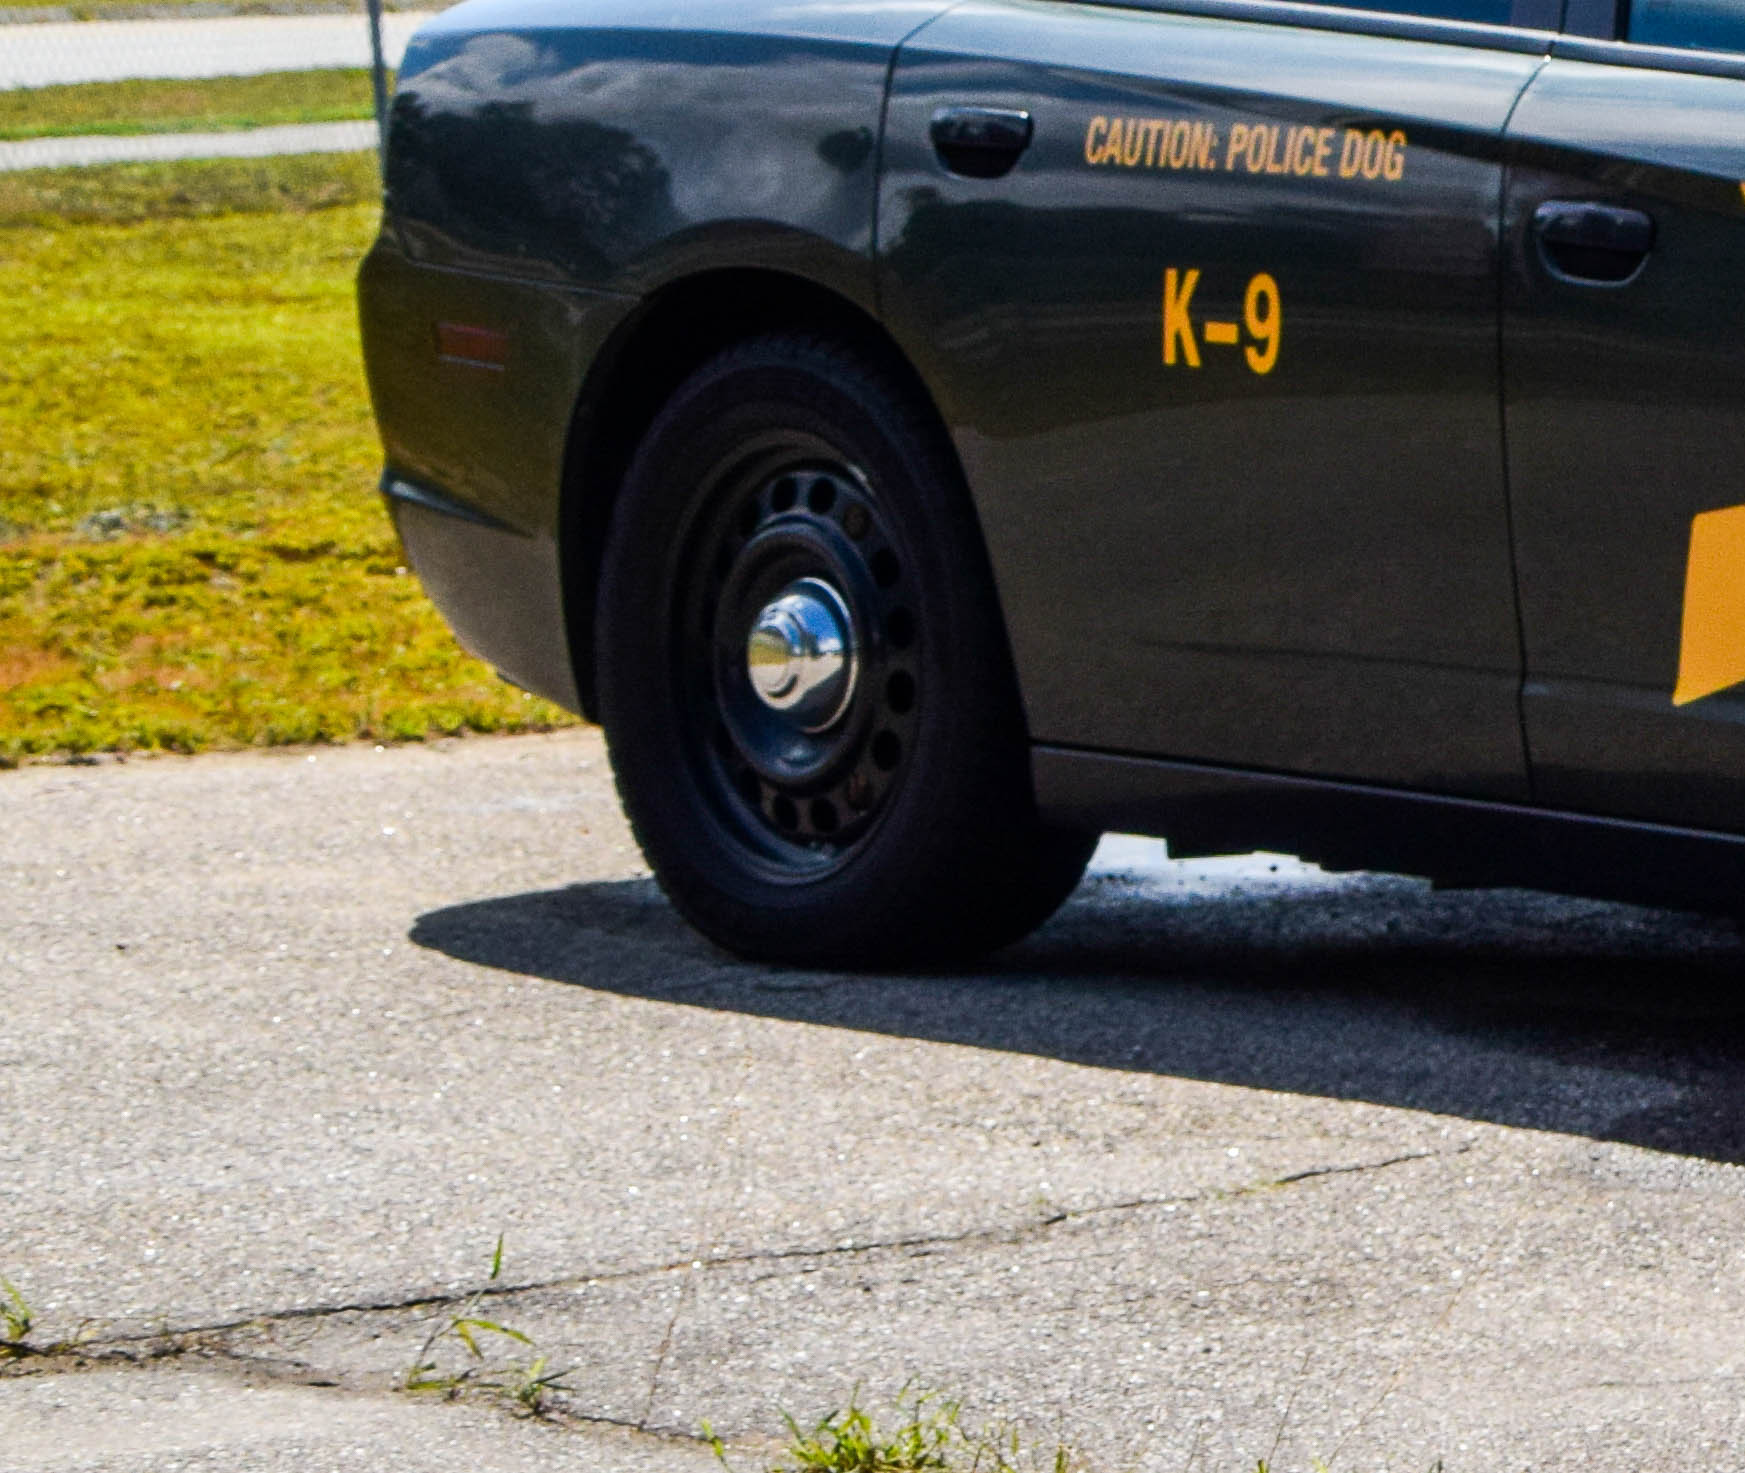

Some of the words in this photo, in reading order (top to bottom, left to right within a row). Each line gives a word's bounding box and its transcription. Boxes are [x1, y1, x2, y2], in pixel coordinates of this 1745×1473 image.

[1085, 116, 1218, 170] CAUTION:
[1226, 122, 1336, 176] POLICE
[1339, 129, 1407, 181] DOG
[1163, 268, 1282, 375] K-9
